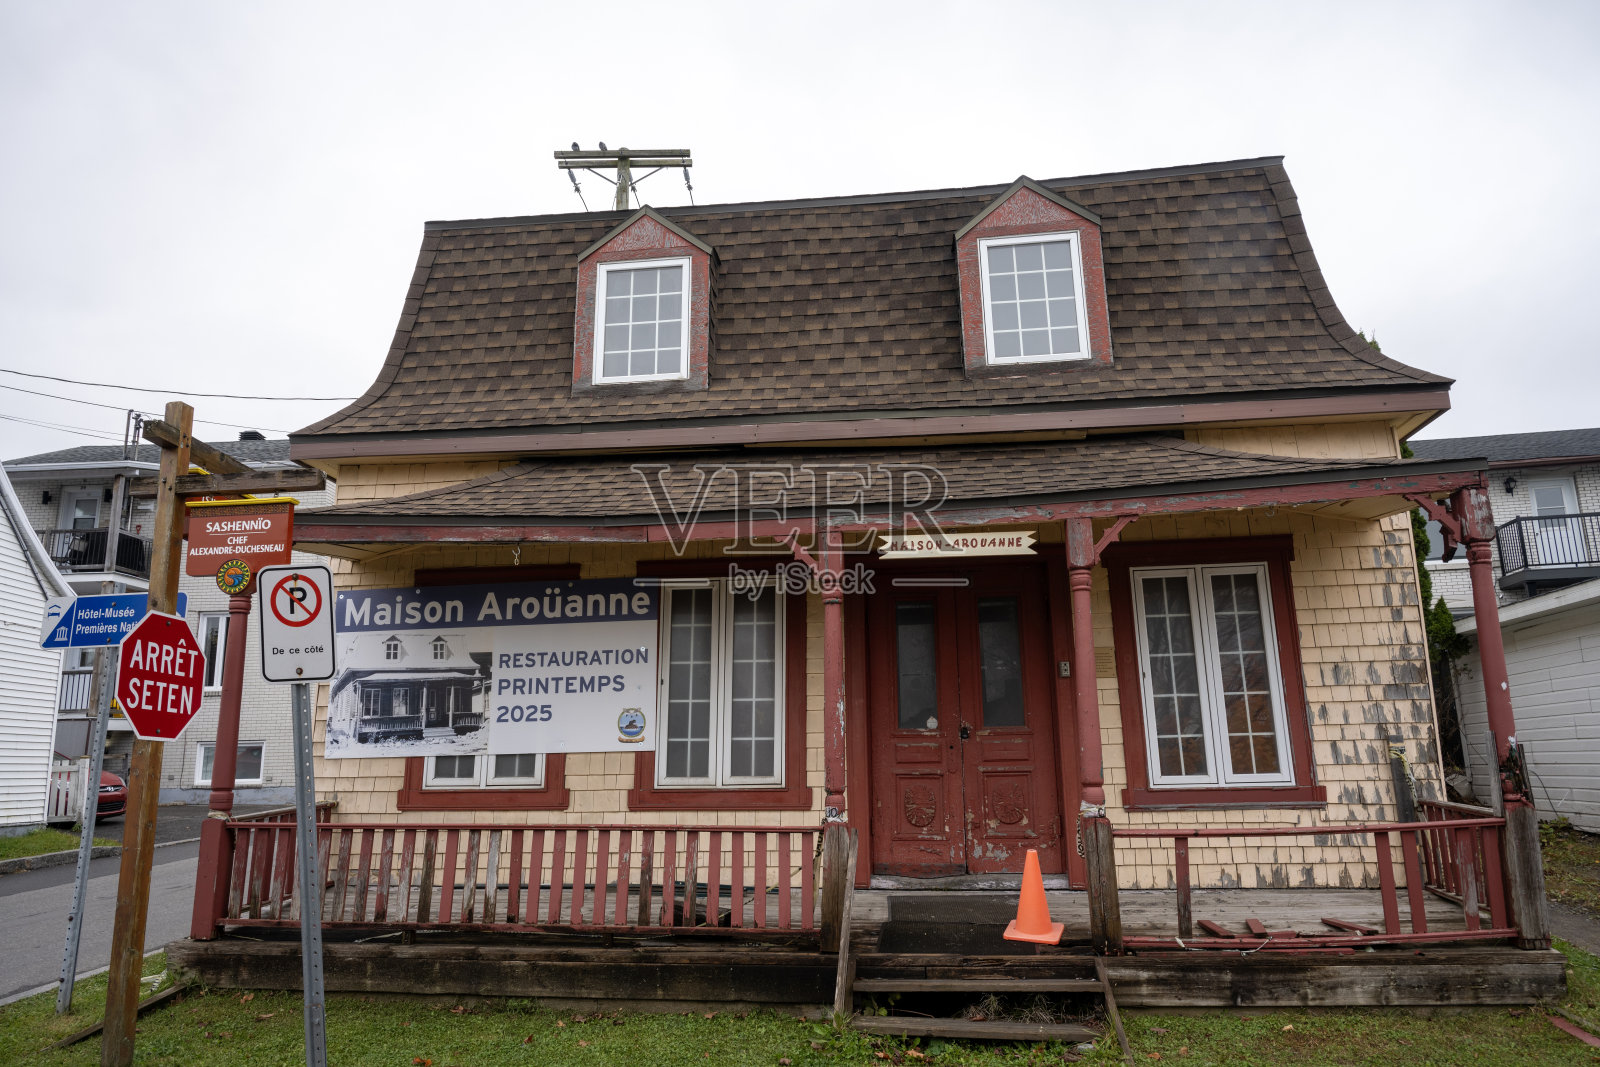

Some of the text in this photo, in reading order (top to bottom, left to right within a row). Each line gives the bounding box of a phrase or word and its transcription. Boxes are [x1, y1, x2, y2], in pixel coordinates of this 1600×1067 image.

[206, 518, 271, 532] SASHENNÏO
[227, 536, 248, 545] CHEF
[190, 544, 285, 556] ALEXANDRE-DUCHESNEAU
[77, 606, 135, 620] Hôtel-Musée
[344, 587, 650, 627] Maison Aroüanne
[75, 623, 118, 635] Premières
[272, 647, 285, 655] De
[304, 644, 324, 654] côté
[129, 638, 199, 678] ARRÊT
[498, 648, 649, 669] RESTAURATION
[497, 674, 626, 696] PRINTEMPS
[126, 677, 194, 715] SETEN
[496, 704, 553, 723] 2025
